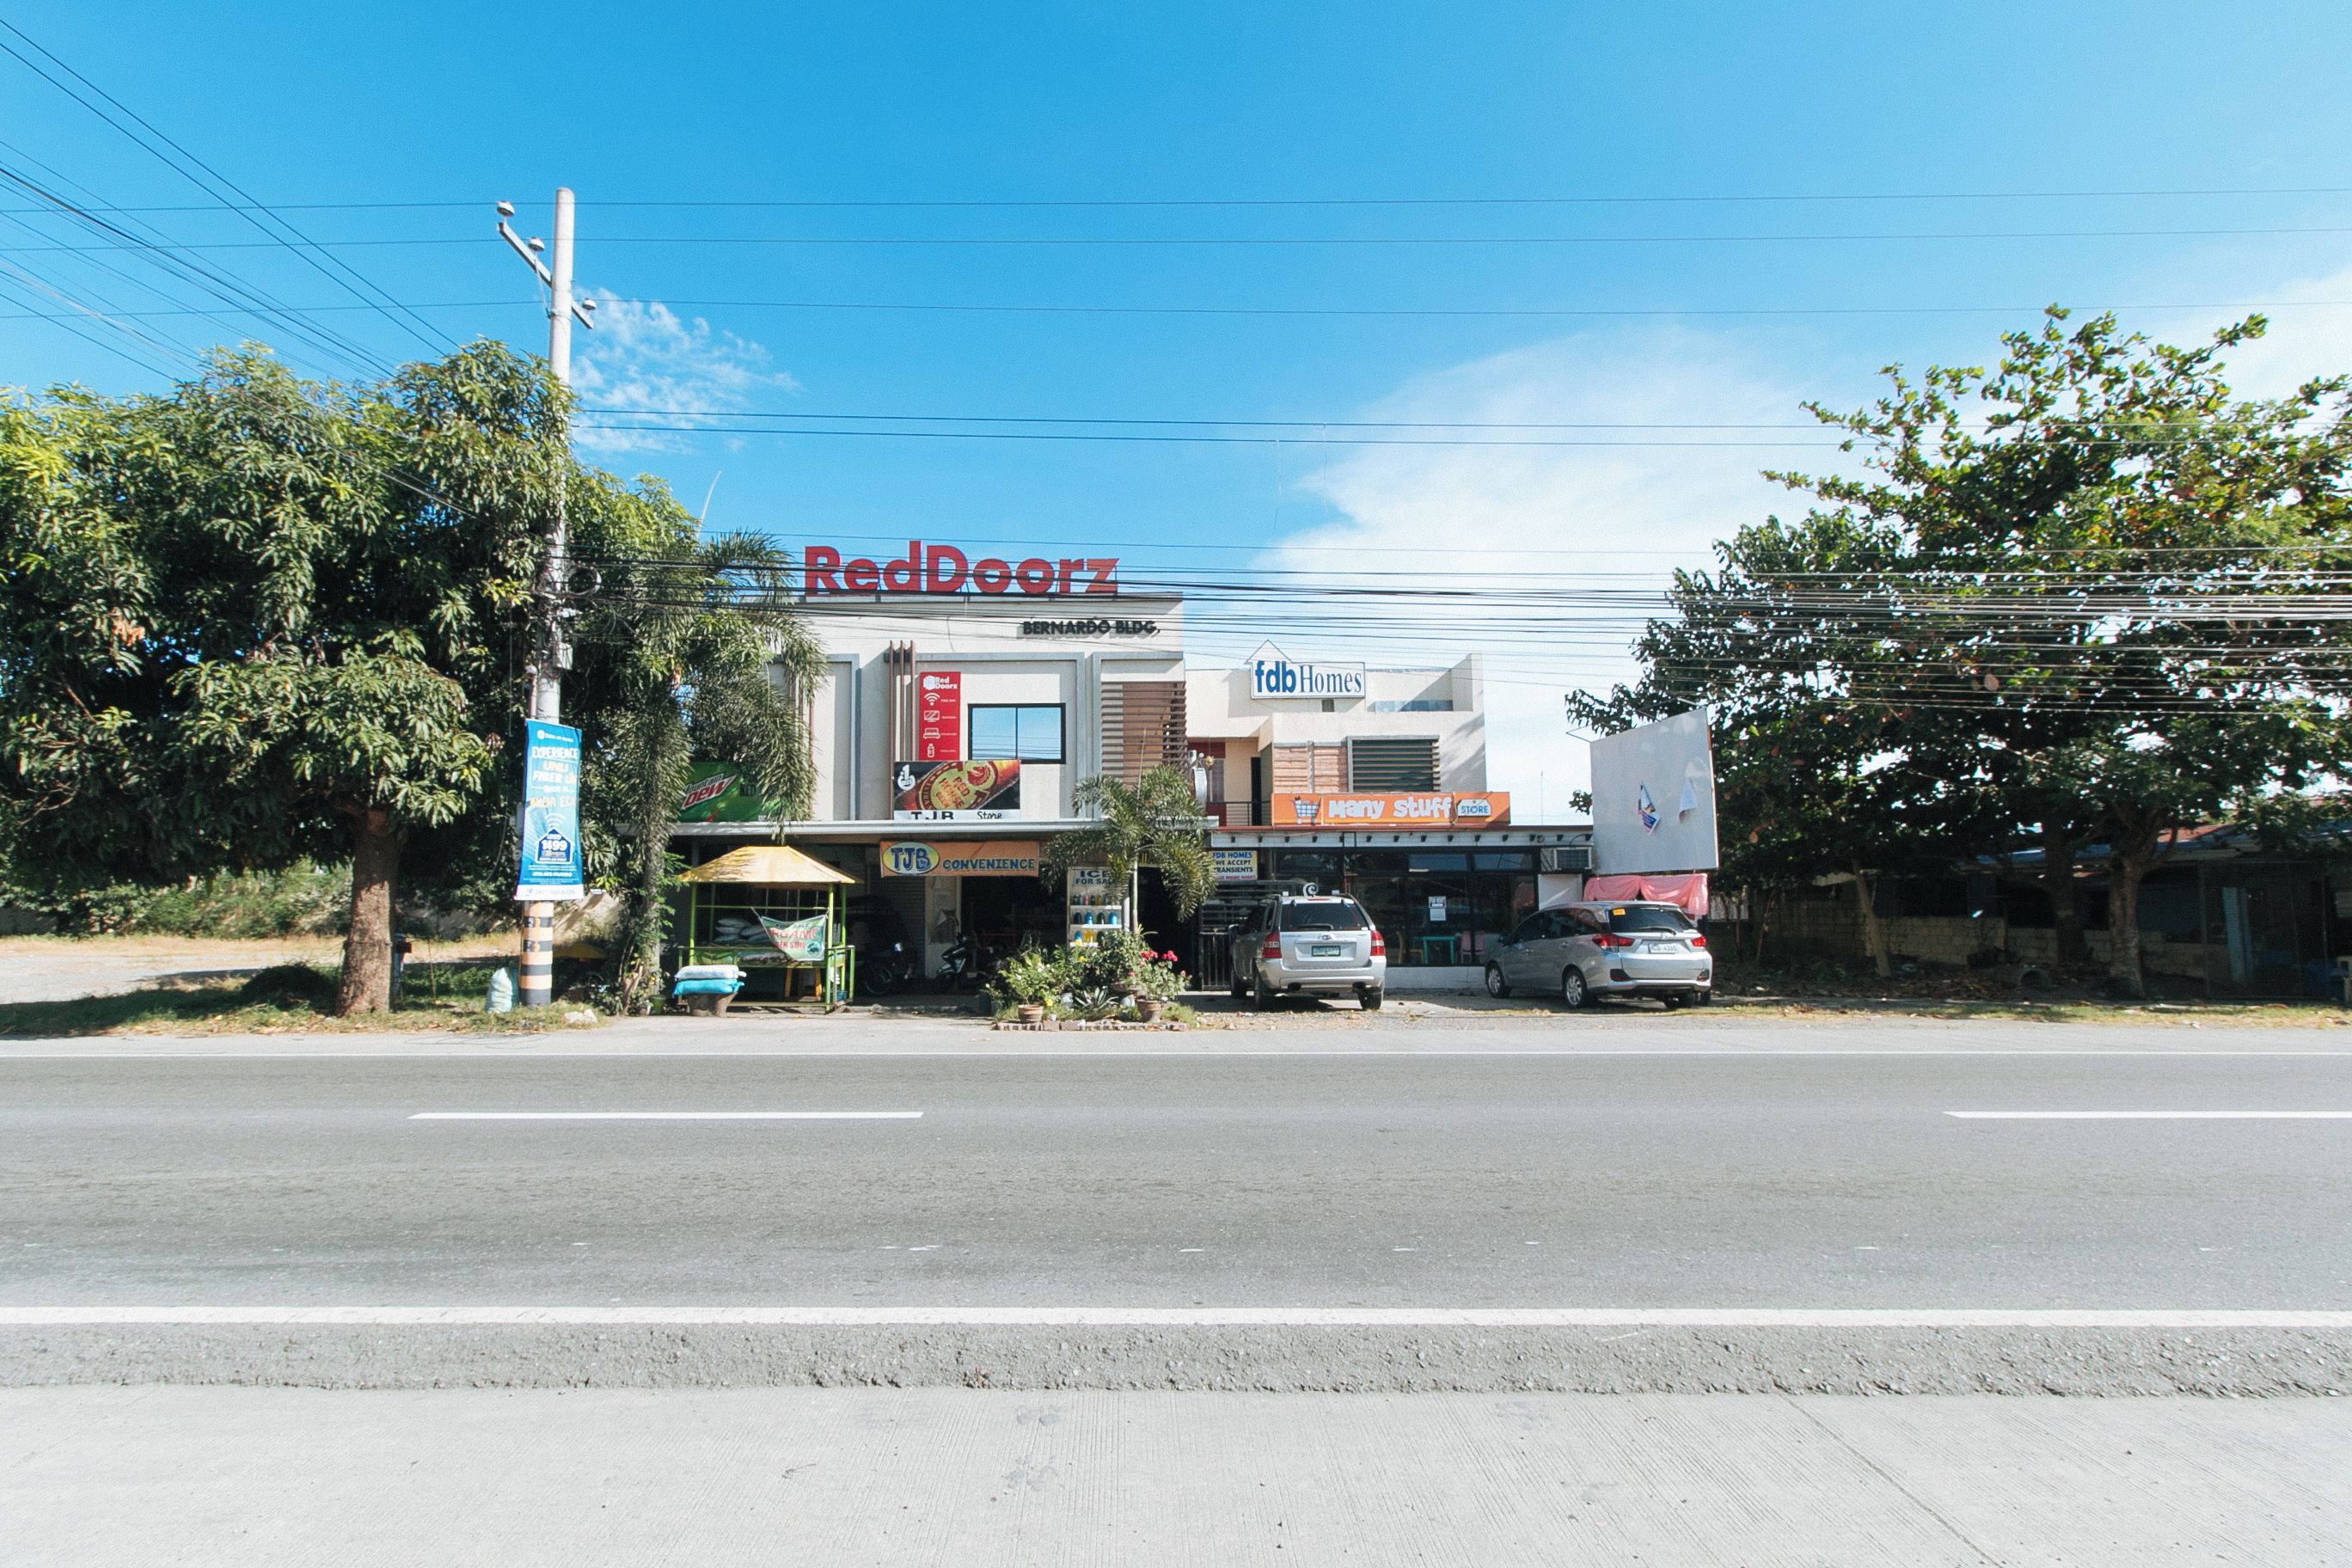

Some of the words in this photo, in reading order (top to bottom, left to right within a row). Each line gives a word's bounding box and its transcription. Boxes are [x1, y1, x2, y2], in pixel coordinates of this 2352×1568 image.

[805, 541, 1119, 597] RedDoorz
[1023, 619, 1111, 634] BERNARDO
[1255, 660, 1296, 693] fdb
[1299, 665, 1363, 693] Homes
[531, 746, 579, 760] EXPERIENCE
[977, 811, 1002, 820] Store
[1461, 805, 1489, 814] STORE
[541, 839, 567, 851] 1499
[891, 848, 931, 871] TJB
[942, 859, 1037, 870] CONVENIENCE
